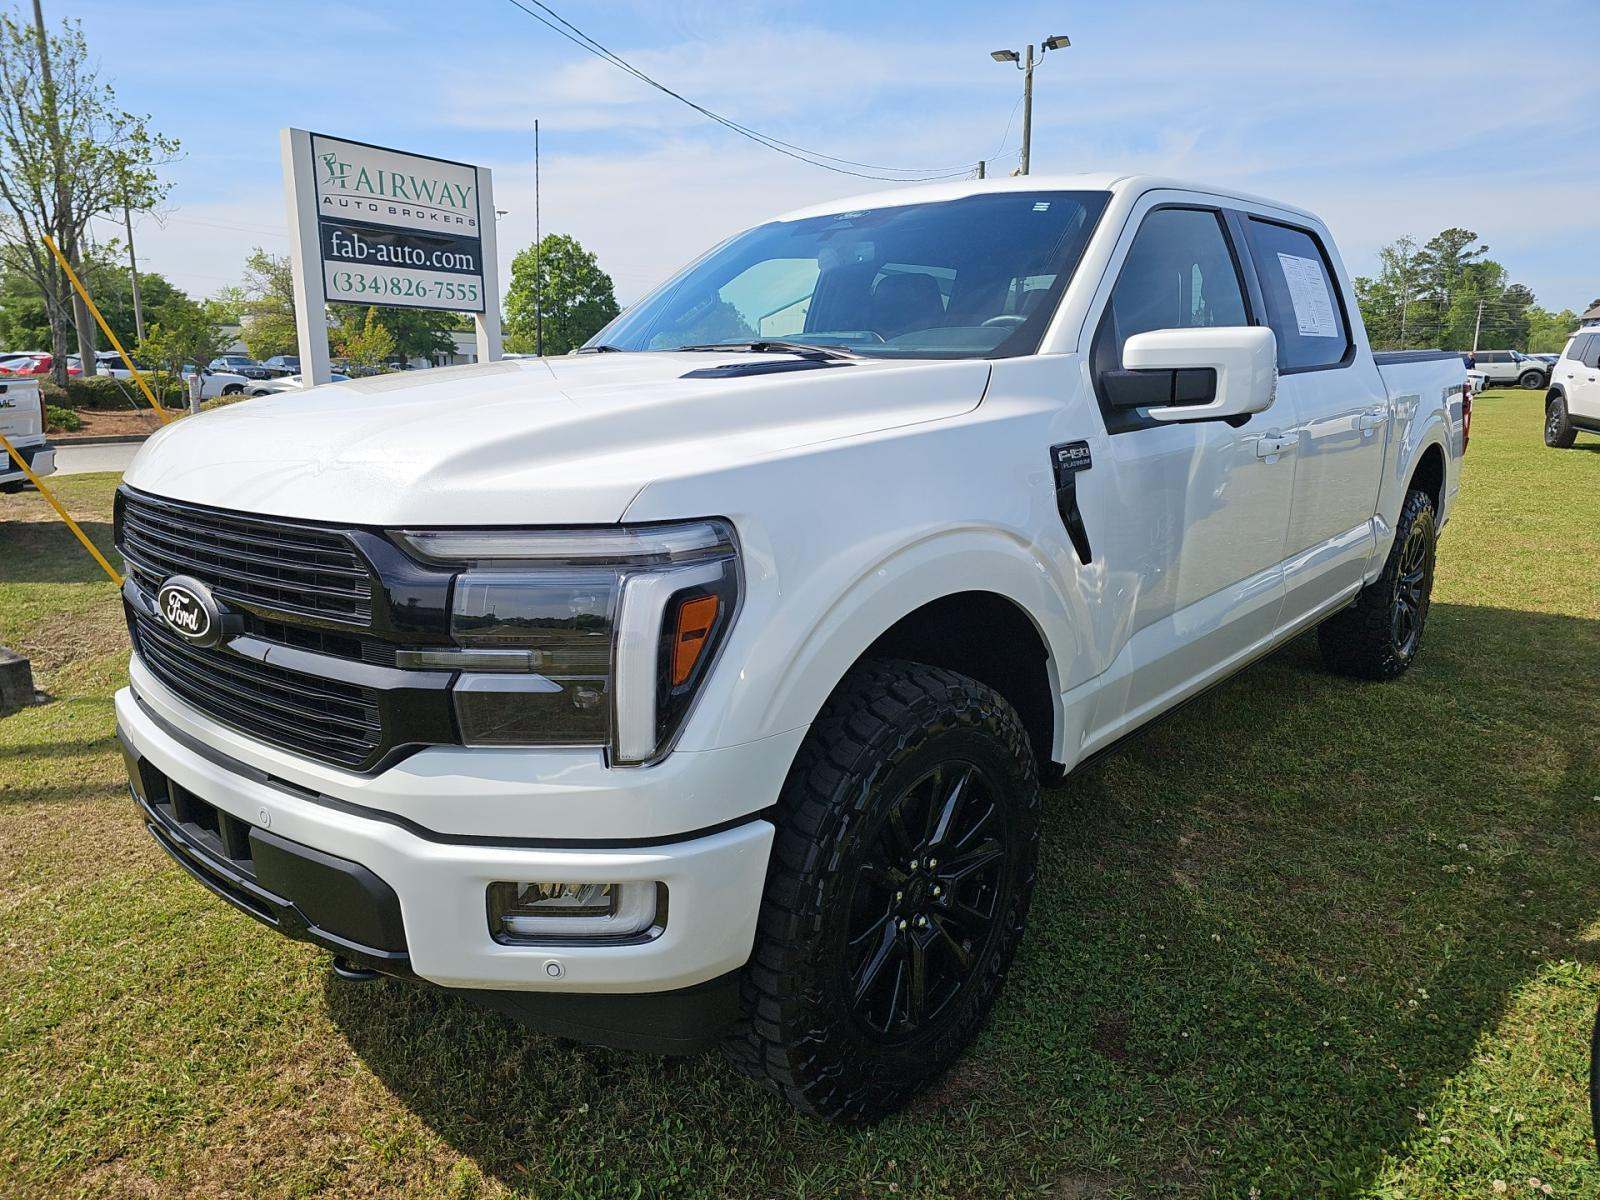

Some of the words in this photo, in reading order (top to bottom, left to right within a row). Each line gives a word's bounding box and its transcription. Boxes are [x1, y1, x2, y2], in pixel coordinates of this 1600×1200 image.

[336, 162, 472, 209] FAIRWAY
[323, 196, 378, 212] AUTO
[388, 206, 476, 227] BROKERS
[331, 231, 475, 270] fab-auto.com
[333, 271, 478, 301] (334)826-7555
[167, 590, 198, 631] Ford
